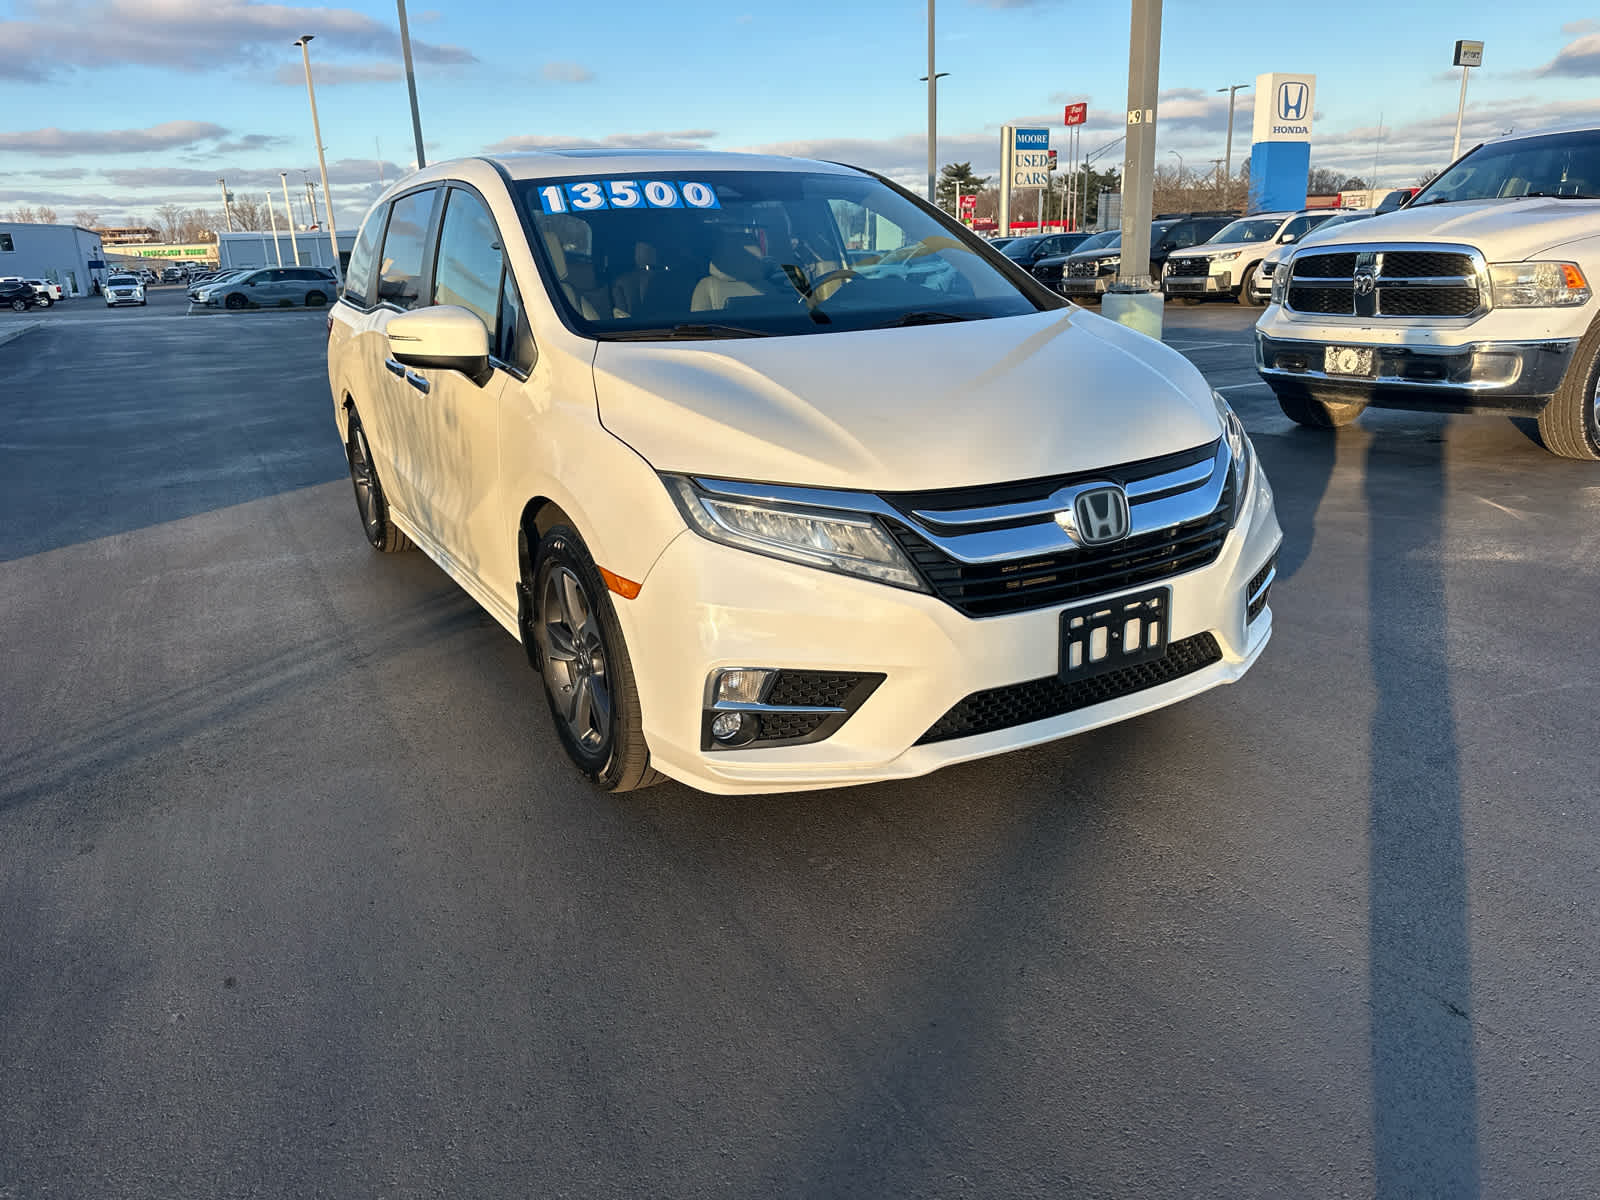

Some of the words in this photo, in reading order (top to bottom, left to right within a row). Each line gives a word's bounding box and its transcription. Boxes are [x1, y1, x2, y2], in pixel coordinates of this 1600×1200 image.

[1273, 126, 1309, 134] HONDA
[1016, 134, 1048, 144] MOORE
[1015, 154, 1048, 168] USED
[1015, 172, 1048, 185] CARS
[541, 180, 716, 213] 13500
